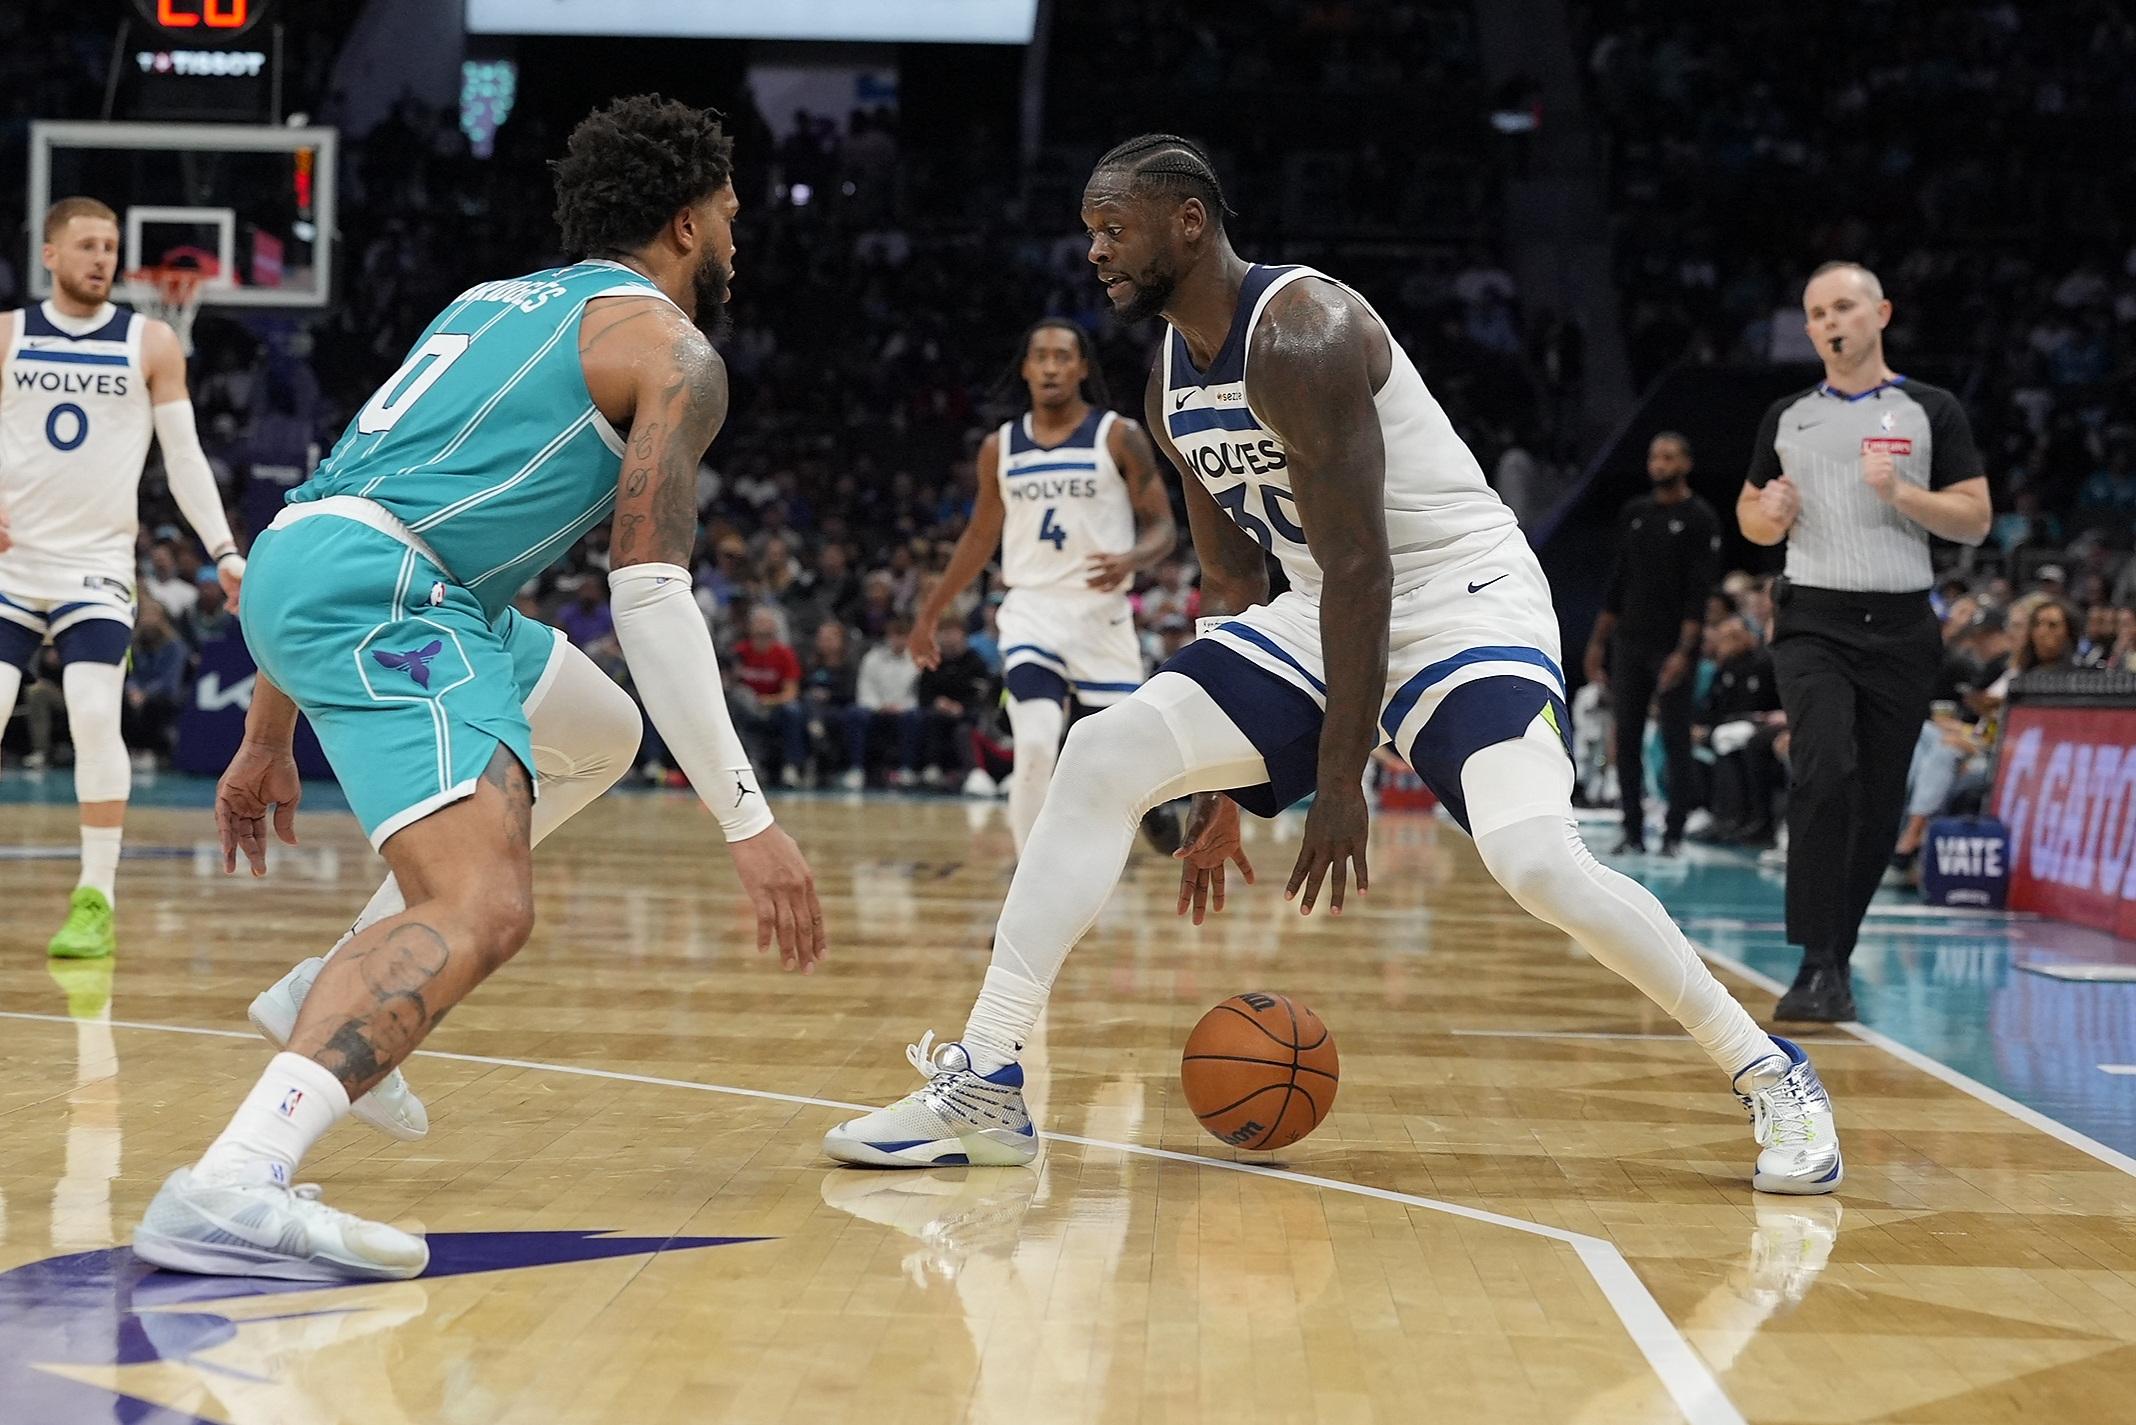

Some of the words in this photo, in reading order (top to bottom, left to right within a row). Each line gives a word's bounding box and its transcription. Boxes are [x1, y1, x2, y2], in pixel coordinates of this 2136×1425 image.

[14, 371, 129, 396] WOLVES
[357, 332, 470, 435] 0
[46, 402, 88, 451] 0
[1008, 479, 1097, 500] WOLVES
[1039, 507, 1066, 550] 4
[2031, 741, 2136, 900] GATO
